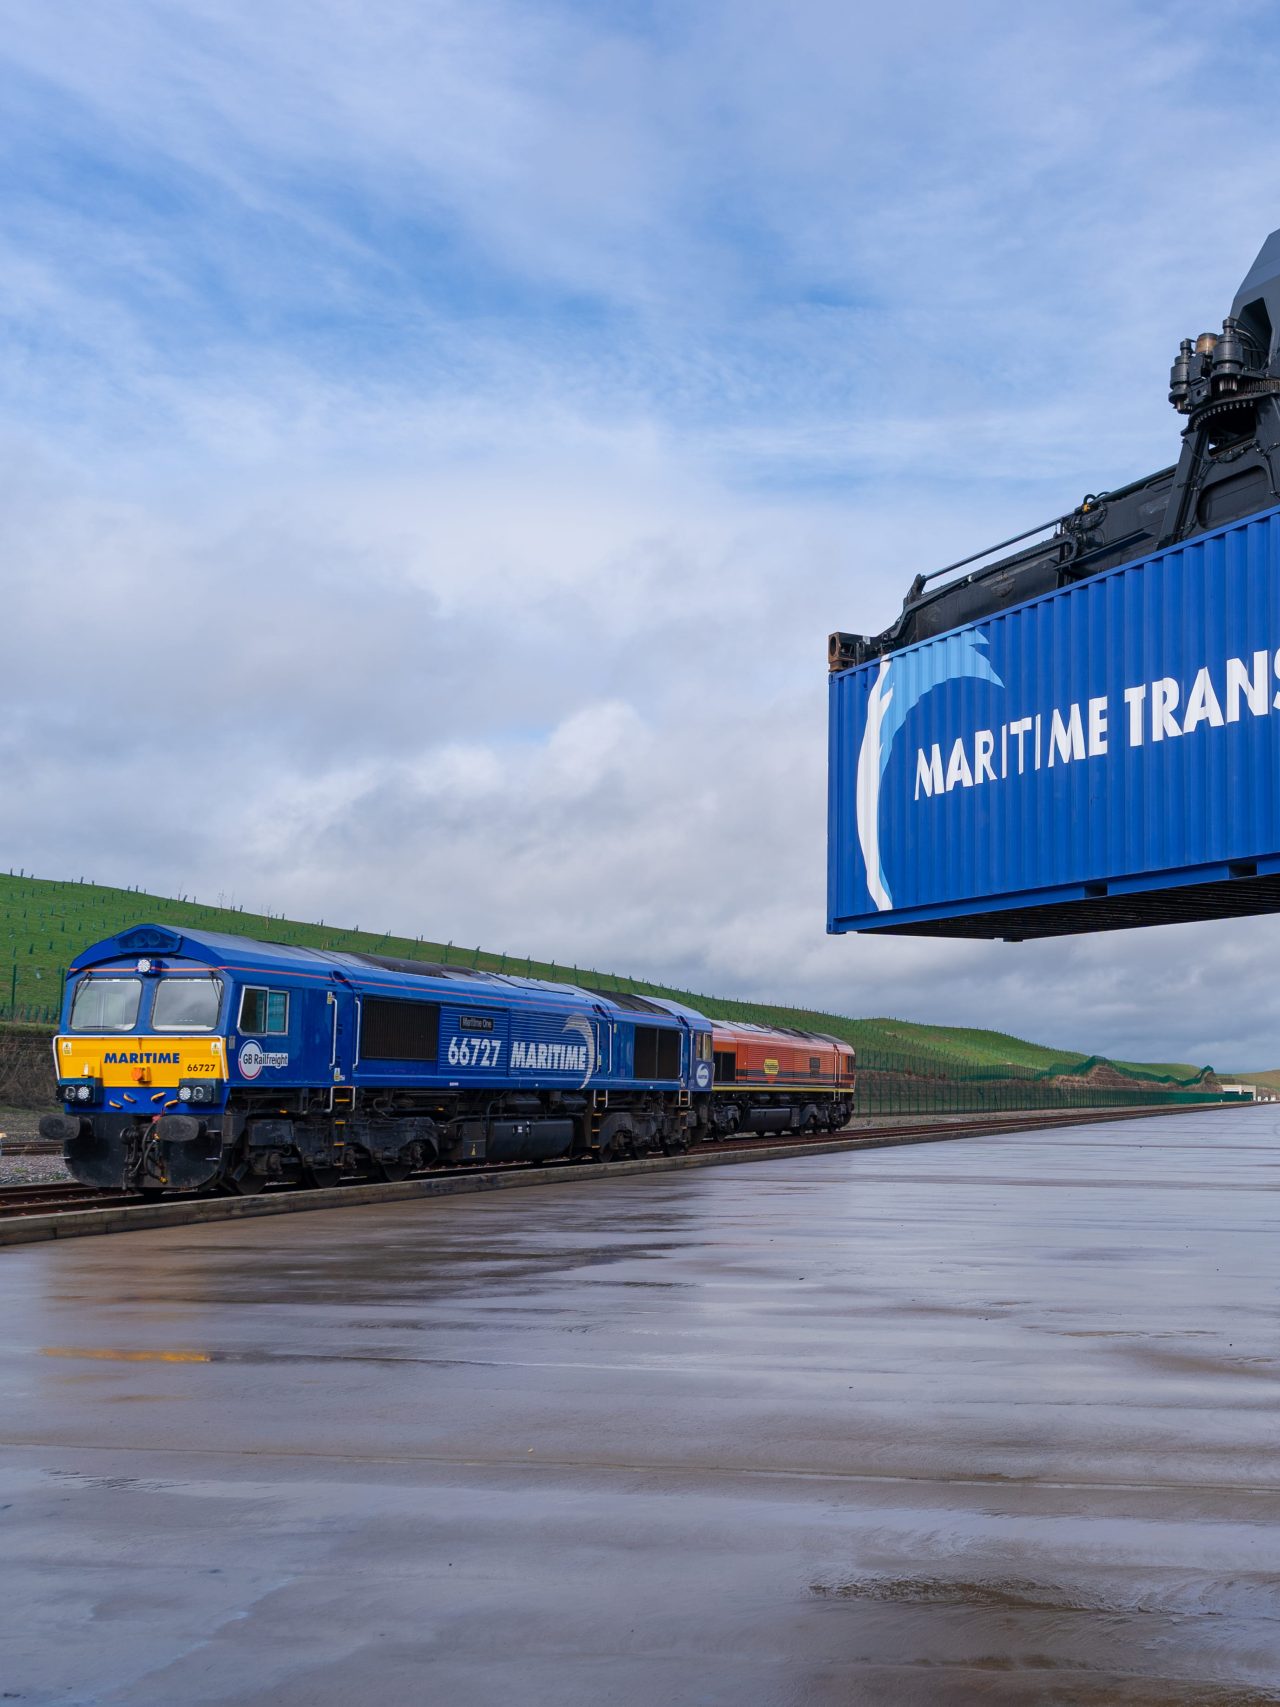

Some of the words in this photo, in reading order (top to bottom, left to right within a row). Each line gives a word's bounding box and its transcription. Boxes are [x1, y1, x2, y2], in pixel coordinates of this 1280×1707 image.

[914, 696, 1108, 800] MARITIME
[103, 1052, 180, 1064] MARITIME
[243, 1053, 253, 1065] GB
[253, 1053, 288, 1067] Railfreight
[447, 1036, 501, 1067] 66727
[510, 1041, 587, 1070] MARITIME
[187, 1064, 216, 1072] 66727
